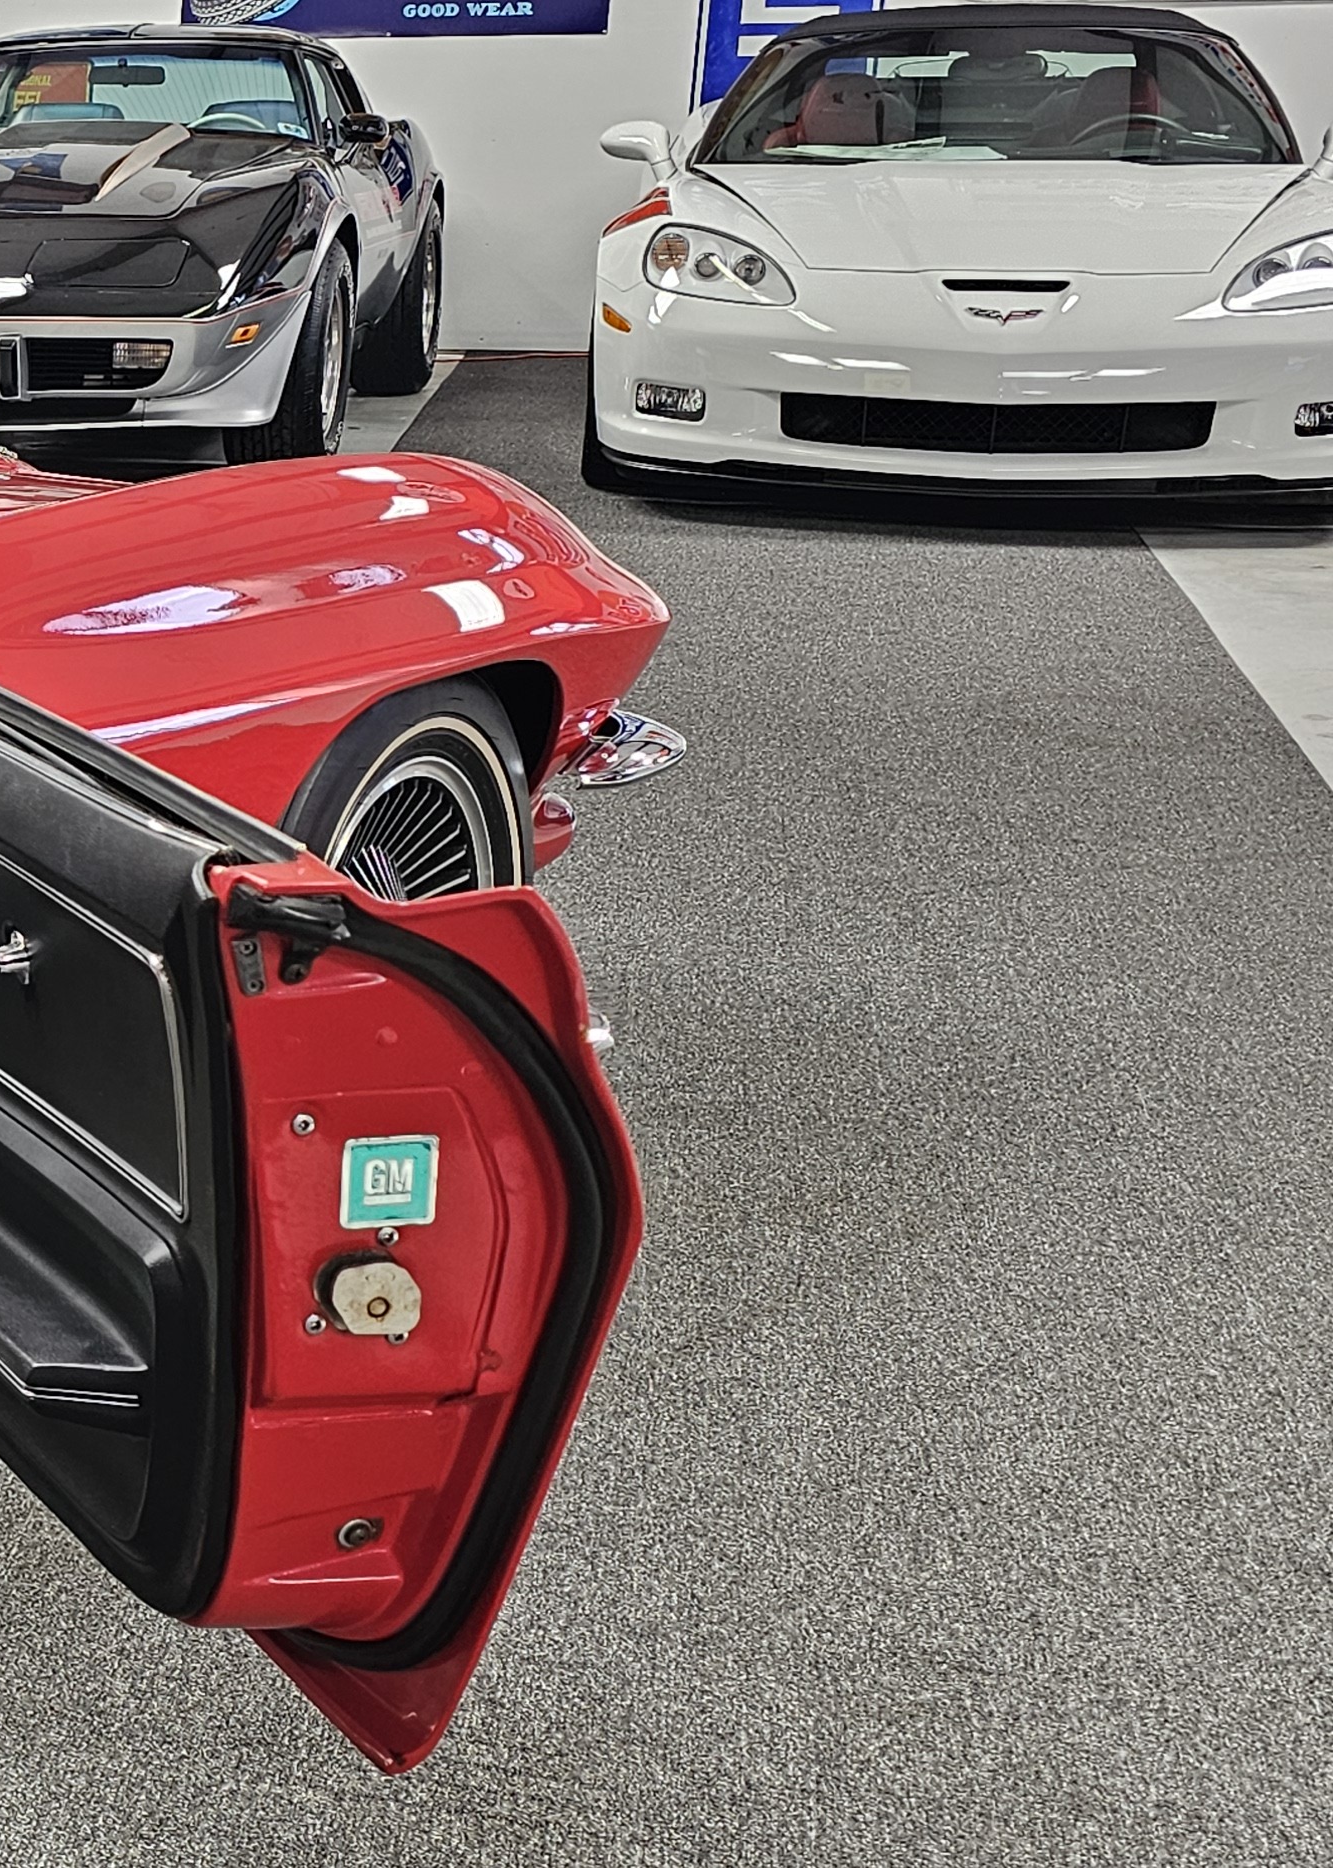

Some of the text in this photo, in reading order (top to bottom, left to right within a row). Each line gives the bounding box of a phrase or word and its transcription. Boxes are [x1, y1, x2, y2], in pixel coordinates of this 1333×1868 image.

[403, 2, 534, 18] GOOD WEAR
[363, 1158, 415, 1195] GM
